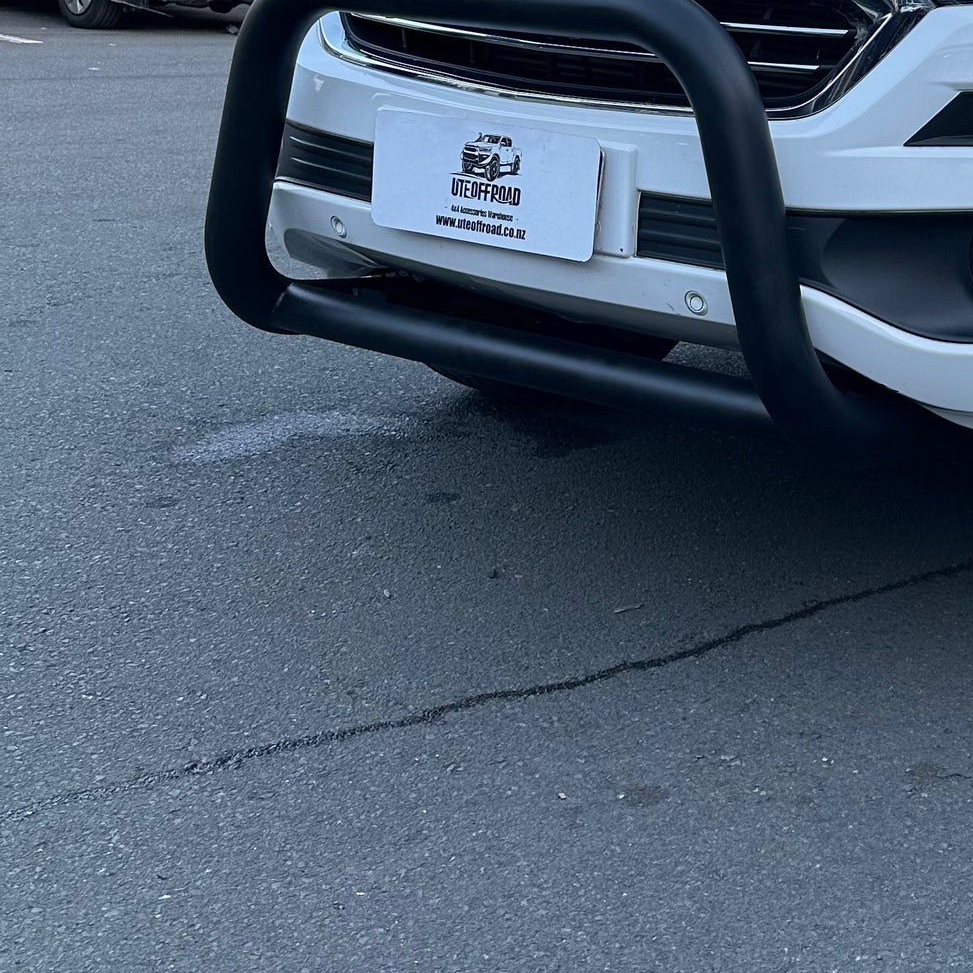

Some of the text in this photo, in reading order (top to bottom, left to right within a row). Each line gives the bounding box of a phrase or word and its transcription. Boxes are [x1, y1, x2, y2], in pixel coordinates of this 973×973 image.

[460, 206, 487, 217] Accessories
[488, 210, 513, 222] Warehouse
[436, 215, 526, 240] www.uteoffroad.co.nz
